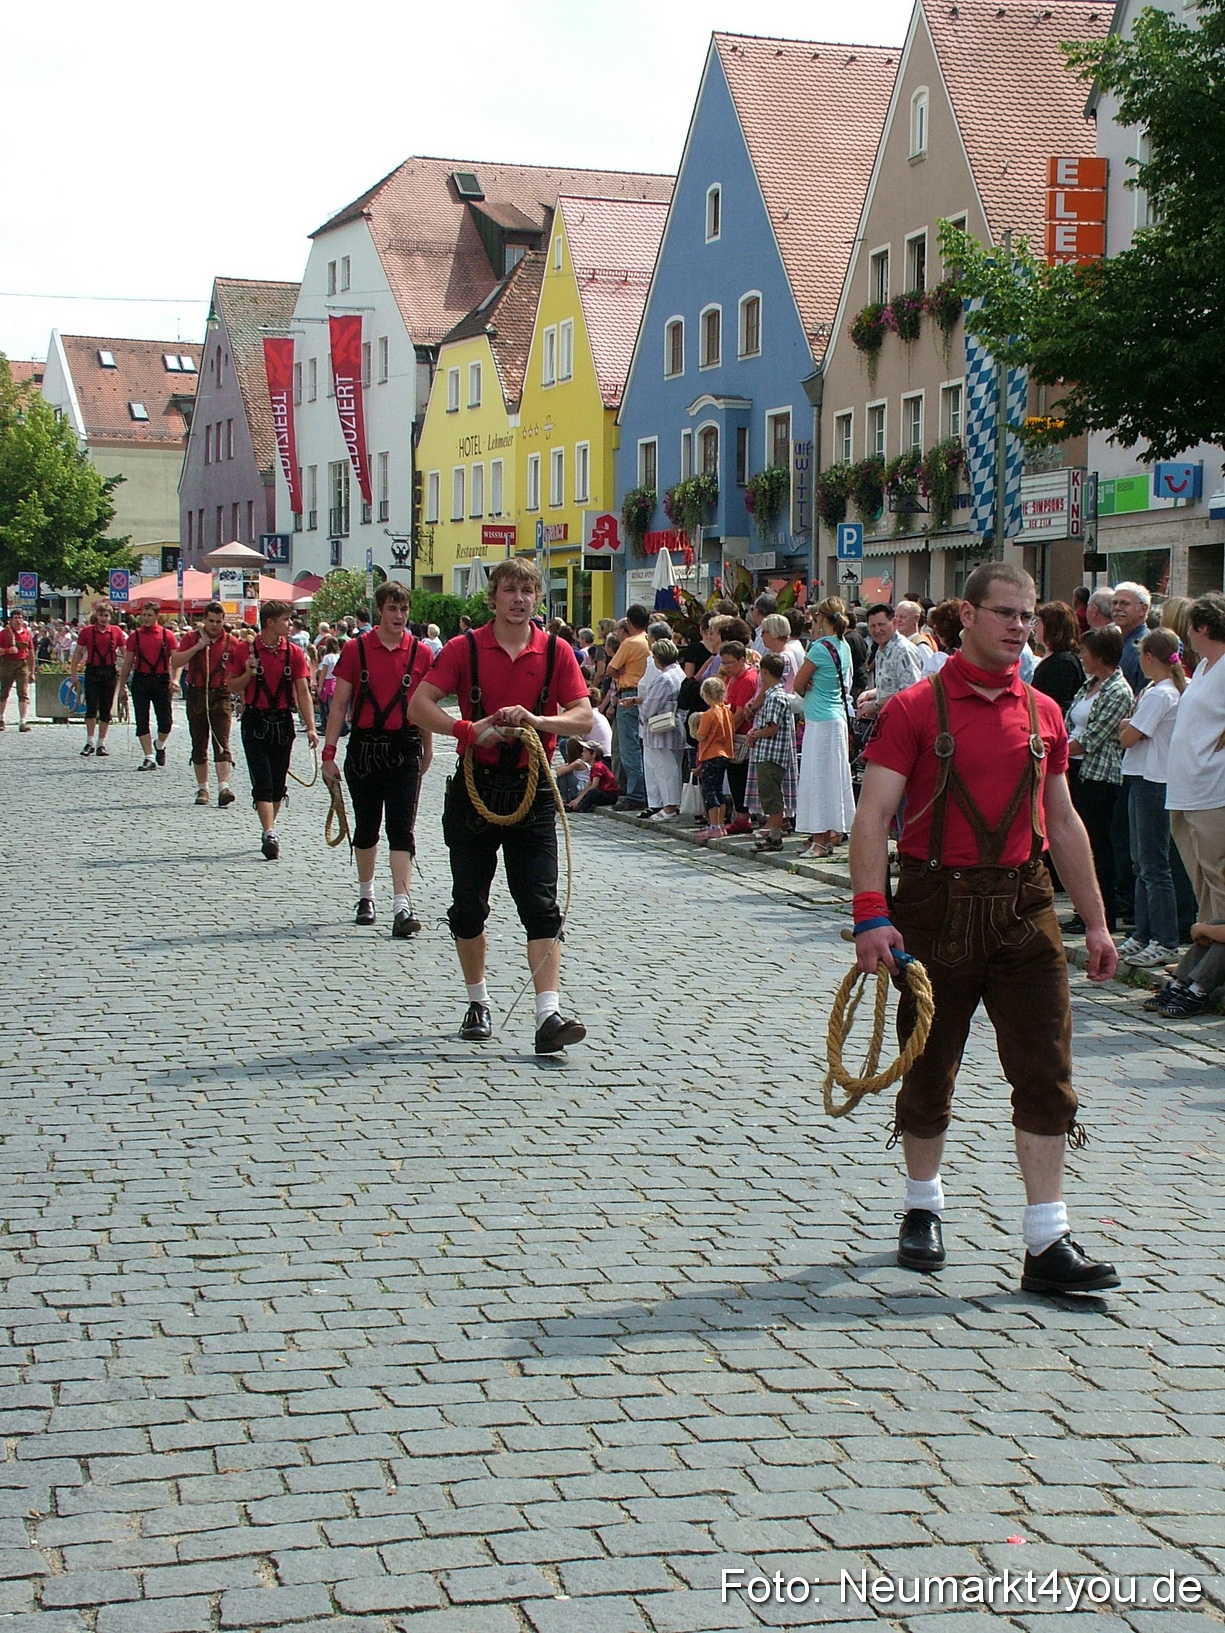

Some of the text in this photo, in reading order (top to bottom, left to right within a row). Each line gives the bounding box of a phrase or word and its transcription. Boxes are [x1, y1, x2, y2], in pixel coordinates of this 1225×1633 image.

[459, 431, 514, 458] HOTEL Lehmeier
[795, 458, 809, 528] WITTL
[1032, 498, 1064, 514] SIMPSONS
[1070, 471, 1080, 535] KINO
[456, 543, 488, 559] Restaurant
[843, 528, 857, 555] P
[111, 591, 128, 599] TAXI
